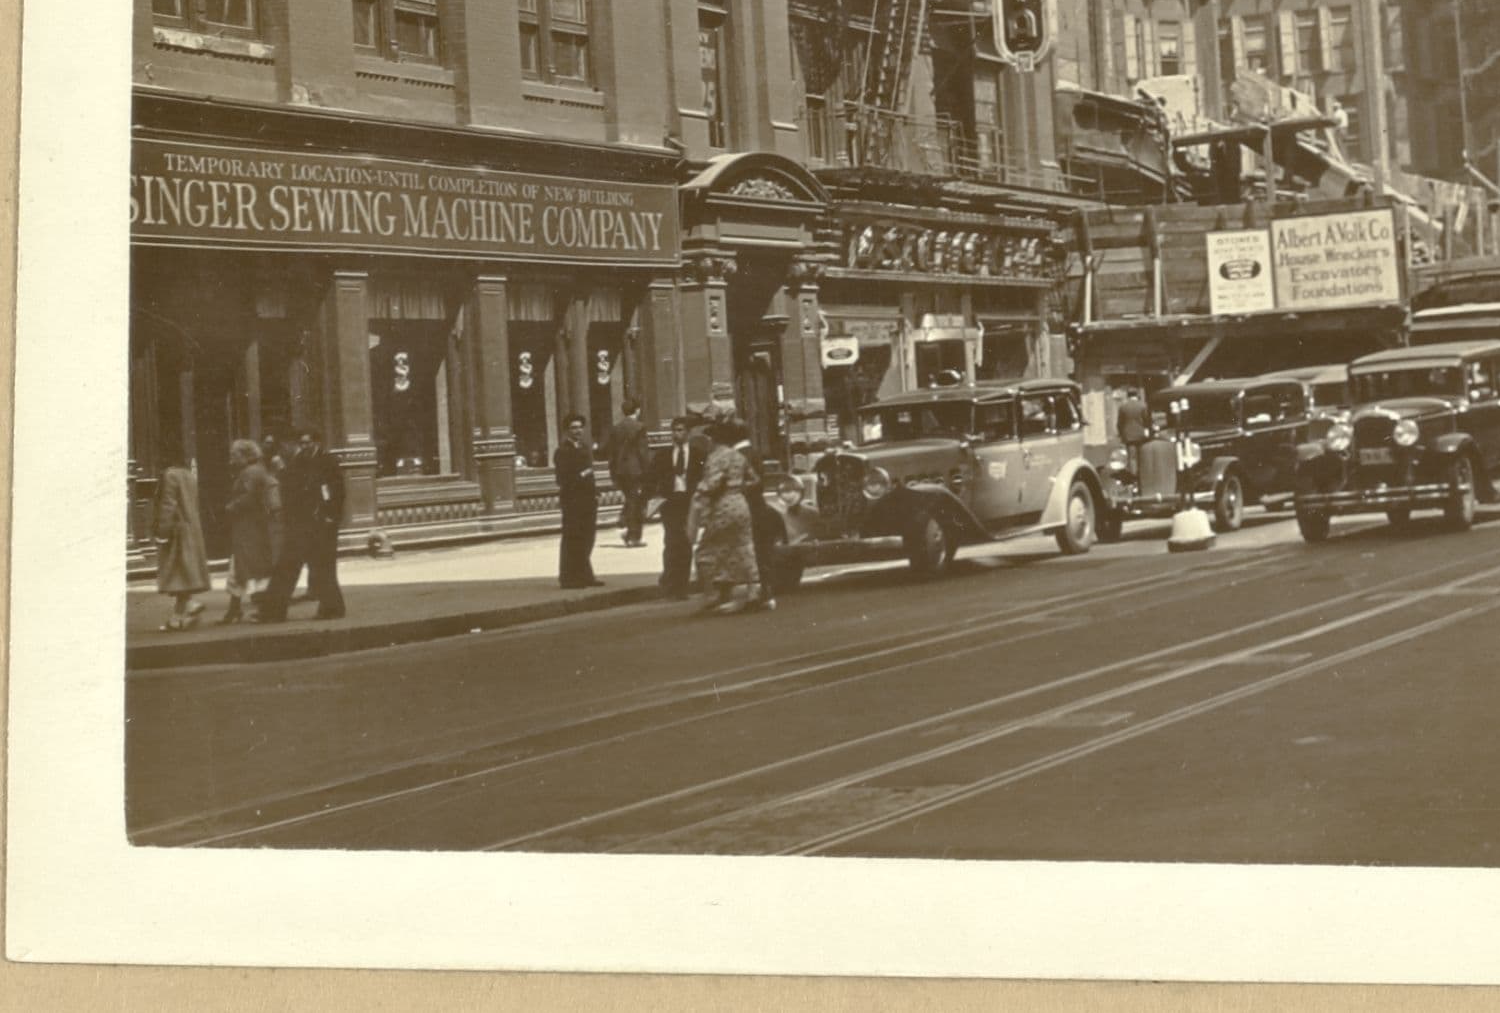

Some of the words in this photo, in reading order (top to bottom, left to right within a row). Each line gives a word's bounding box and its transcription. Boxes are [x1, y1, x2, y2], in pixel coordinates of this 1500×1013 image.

[164, 152, 284, 180] TEMPORARY
[428, 174, 518, 198] COMPLETION
[522, 185, 538, 200] OF
[544, 186, 574, 203] NEW
[578, 188, 635, 207] BUILDING
[130, 174, 264, 232] SINGER
[269, 184, 397, 236] SEWING
[401, 193, 535, 245] MACHINE
[542, 205, 663, 251] COMPANY
[1276, 227, 1323, 251] Albert
[1279, 252, 1321, 267] House
[1325, 246, 1391, 263] Wreckers
[1290, 267, 1382, 284] Excavators
[1291, 282, 1383, 301] Foundations
